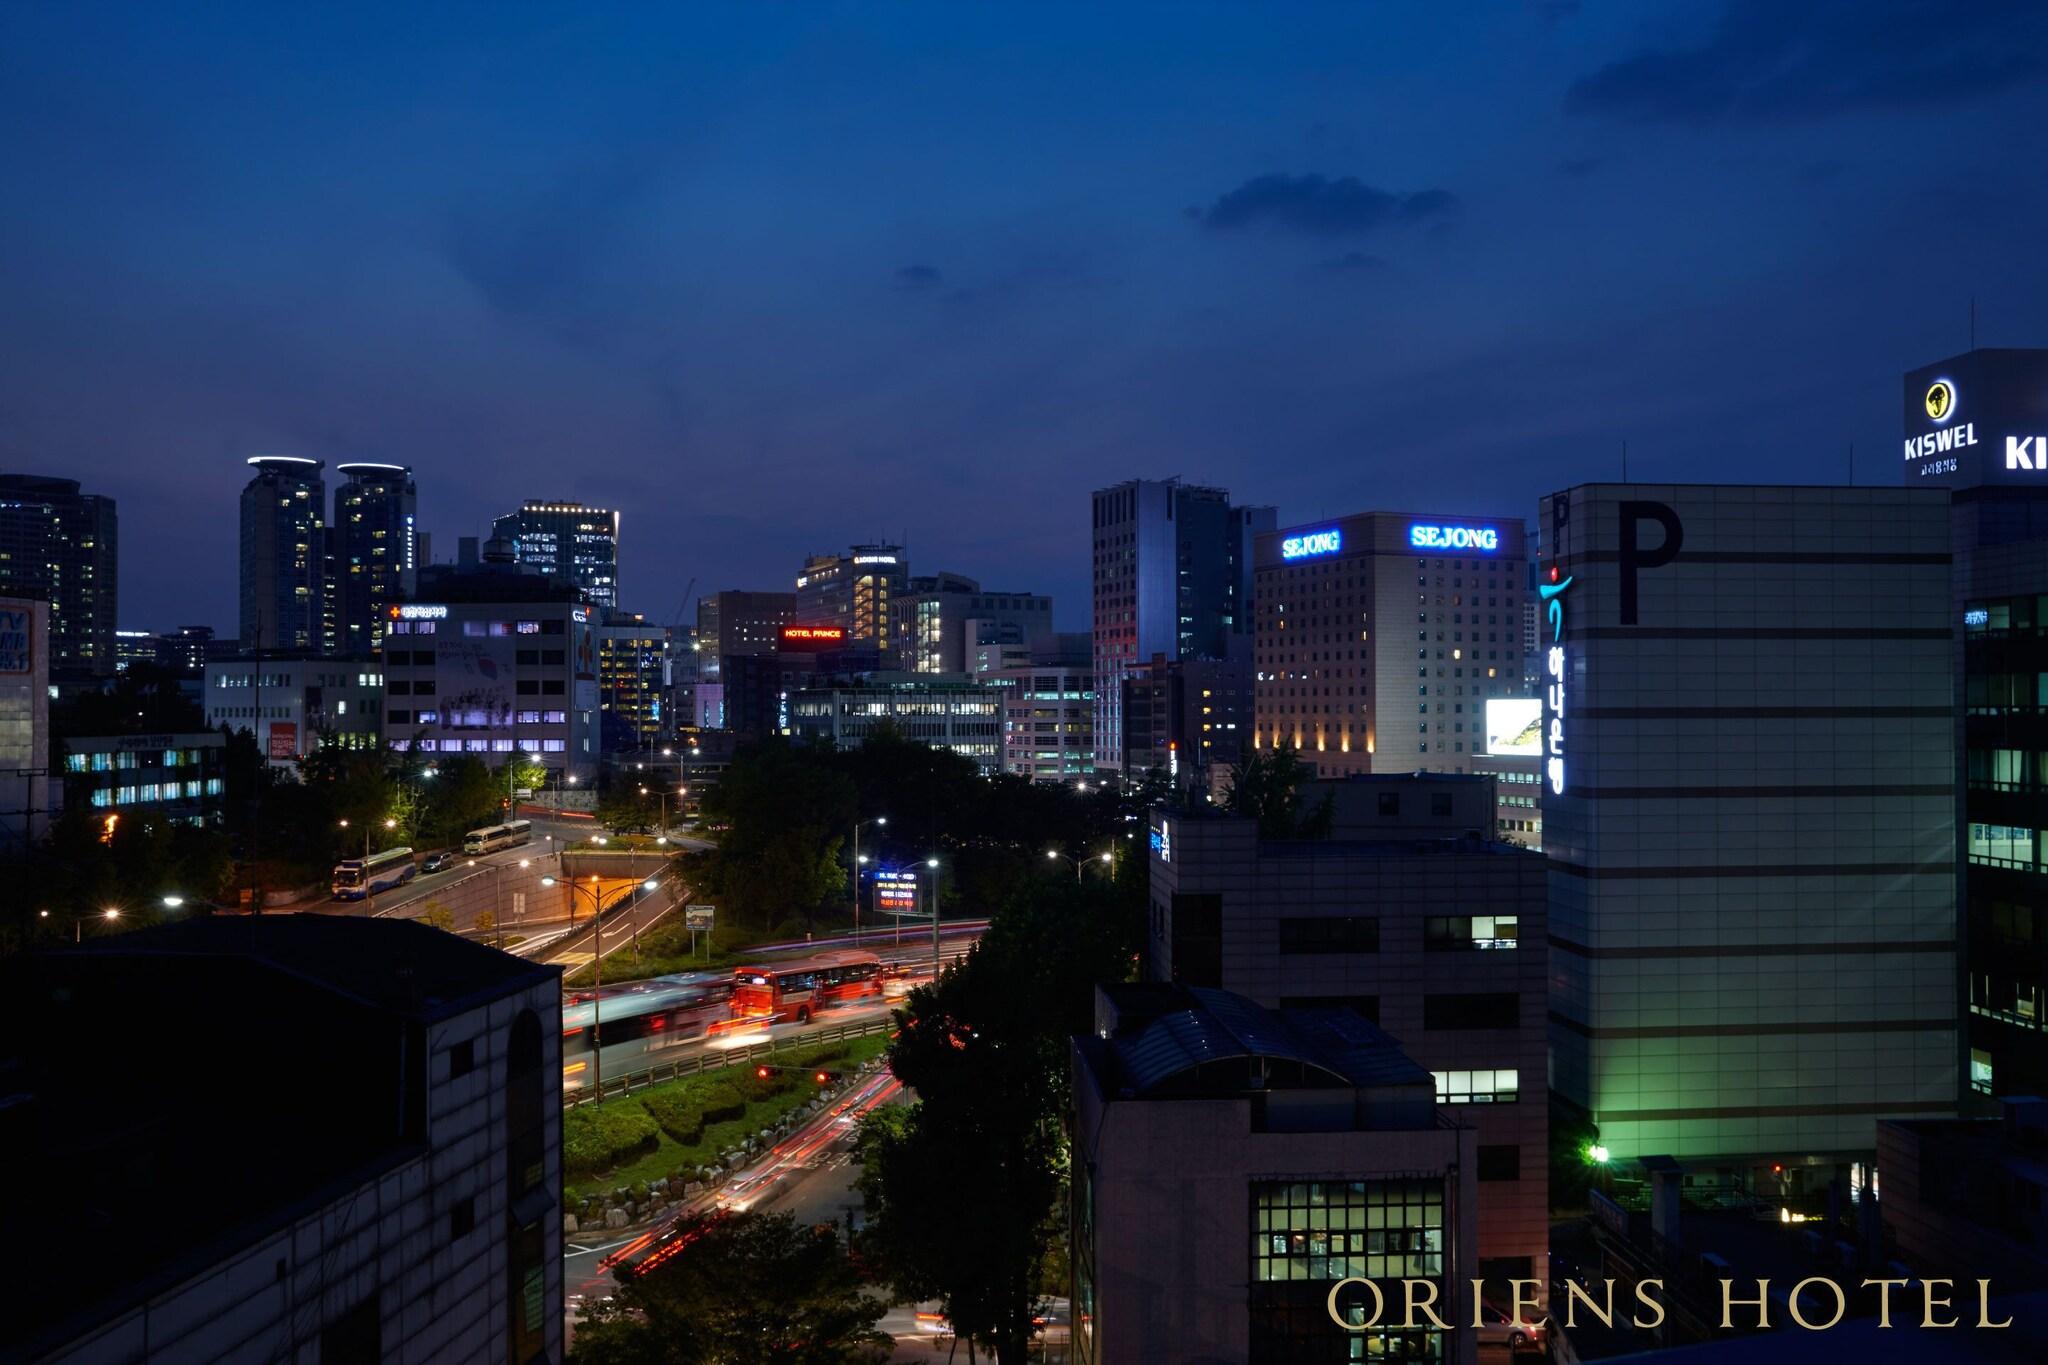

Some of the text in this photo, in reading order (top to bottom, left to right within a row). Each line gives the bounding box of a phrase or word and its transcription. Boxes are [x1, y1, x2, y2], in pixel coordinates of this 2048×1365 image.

[1904, 422, 1978, 461] KISWEL
[1282, 531, 1338, 558] SEJONG
[1412, 526, 1498, 549] SEJONG
[1553, 495, 1569, 554] P
[1619, 501, 1684, 625] P
[1548, 646, 1565, 795] 하나은행
